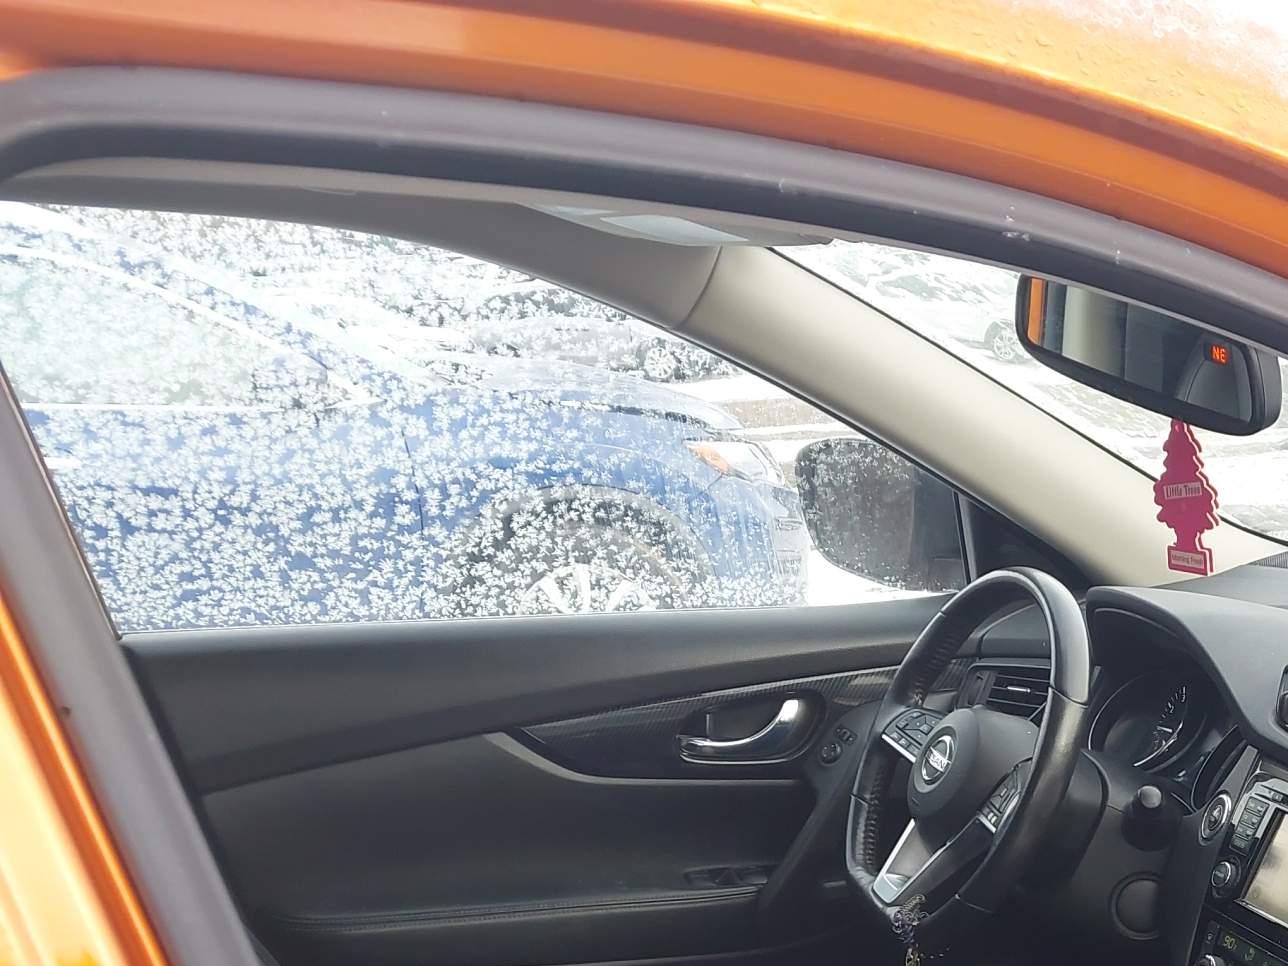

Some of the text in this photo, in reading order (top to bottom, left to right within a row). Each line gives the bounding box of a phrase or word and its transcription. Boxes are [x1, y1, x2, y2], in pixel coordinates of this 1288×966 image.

[1212, 345, 1226, 363] NE
[1165, 483, 1201, 499] Little Trees
